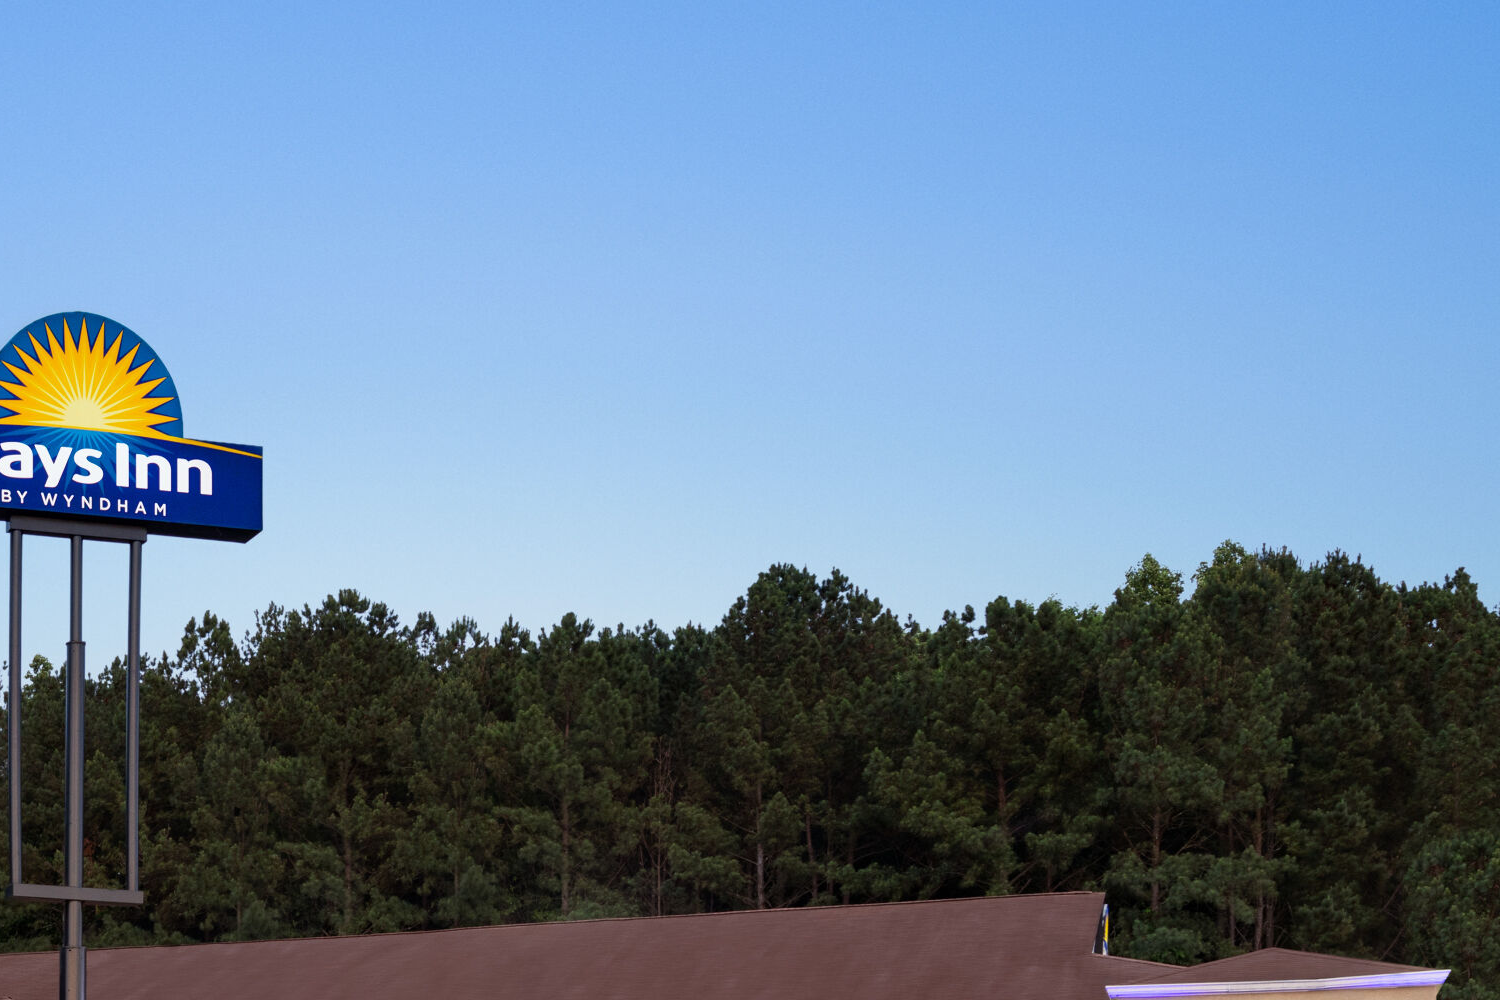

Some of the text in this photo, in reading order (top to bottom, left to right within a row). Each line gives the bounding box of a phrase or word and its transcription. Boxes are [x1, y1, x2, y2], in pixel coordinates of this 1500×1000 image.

[115, 442, 214, 496] Inn
[1, 488, 168, 517] BY WYNDHAM
